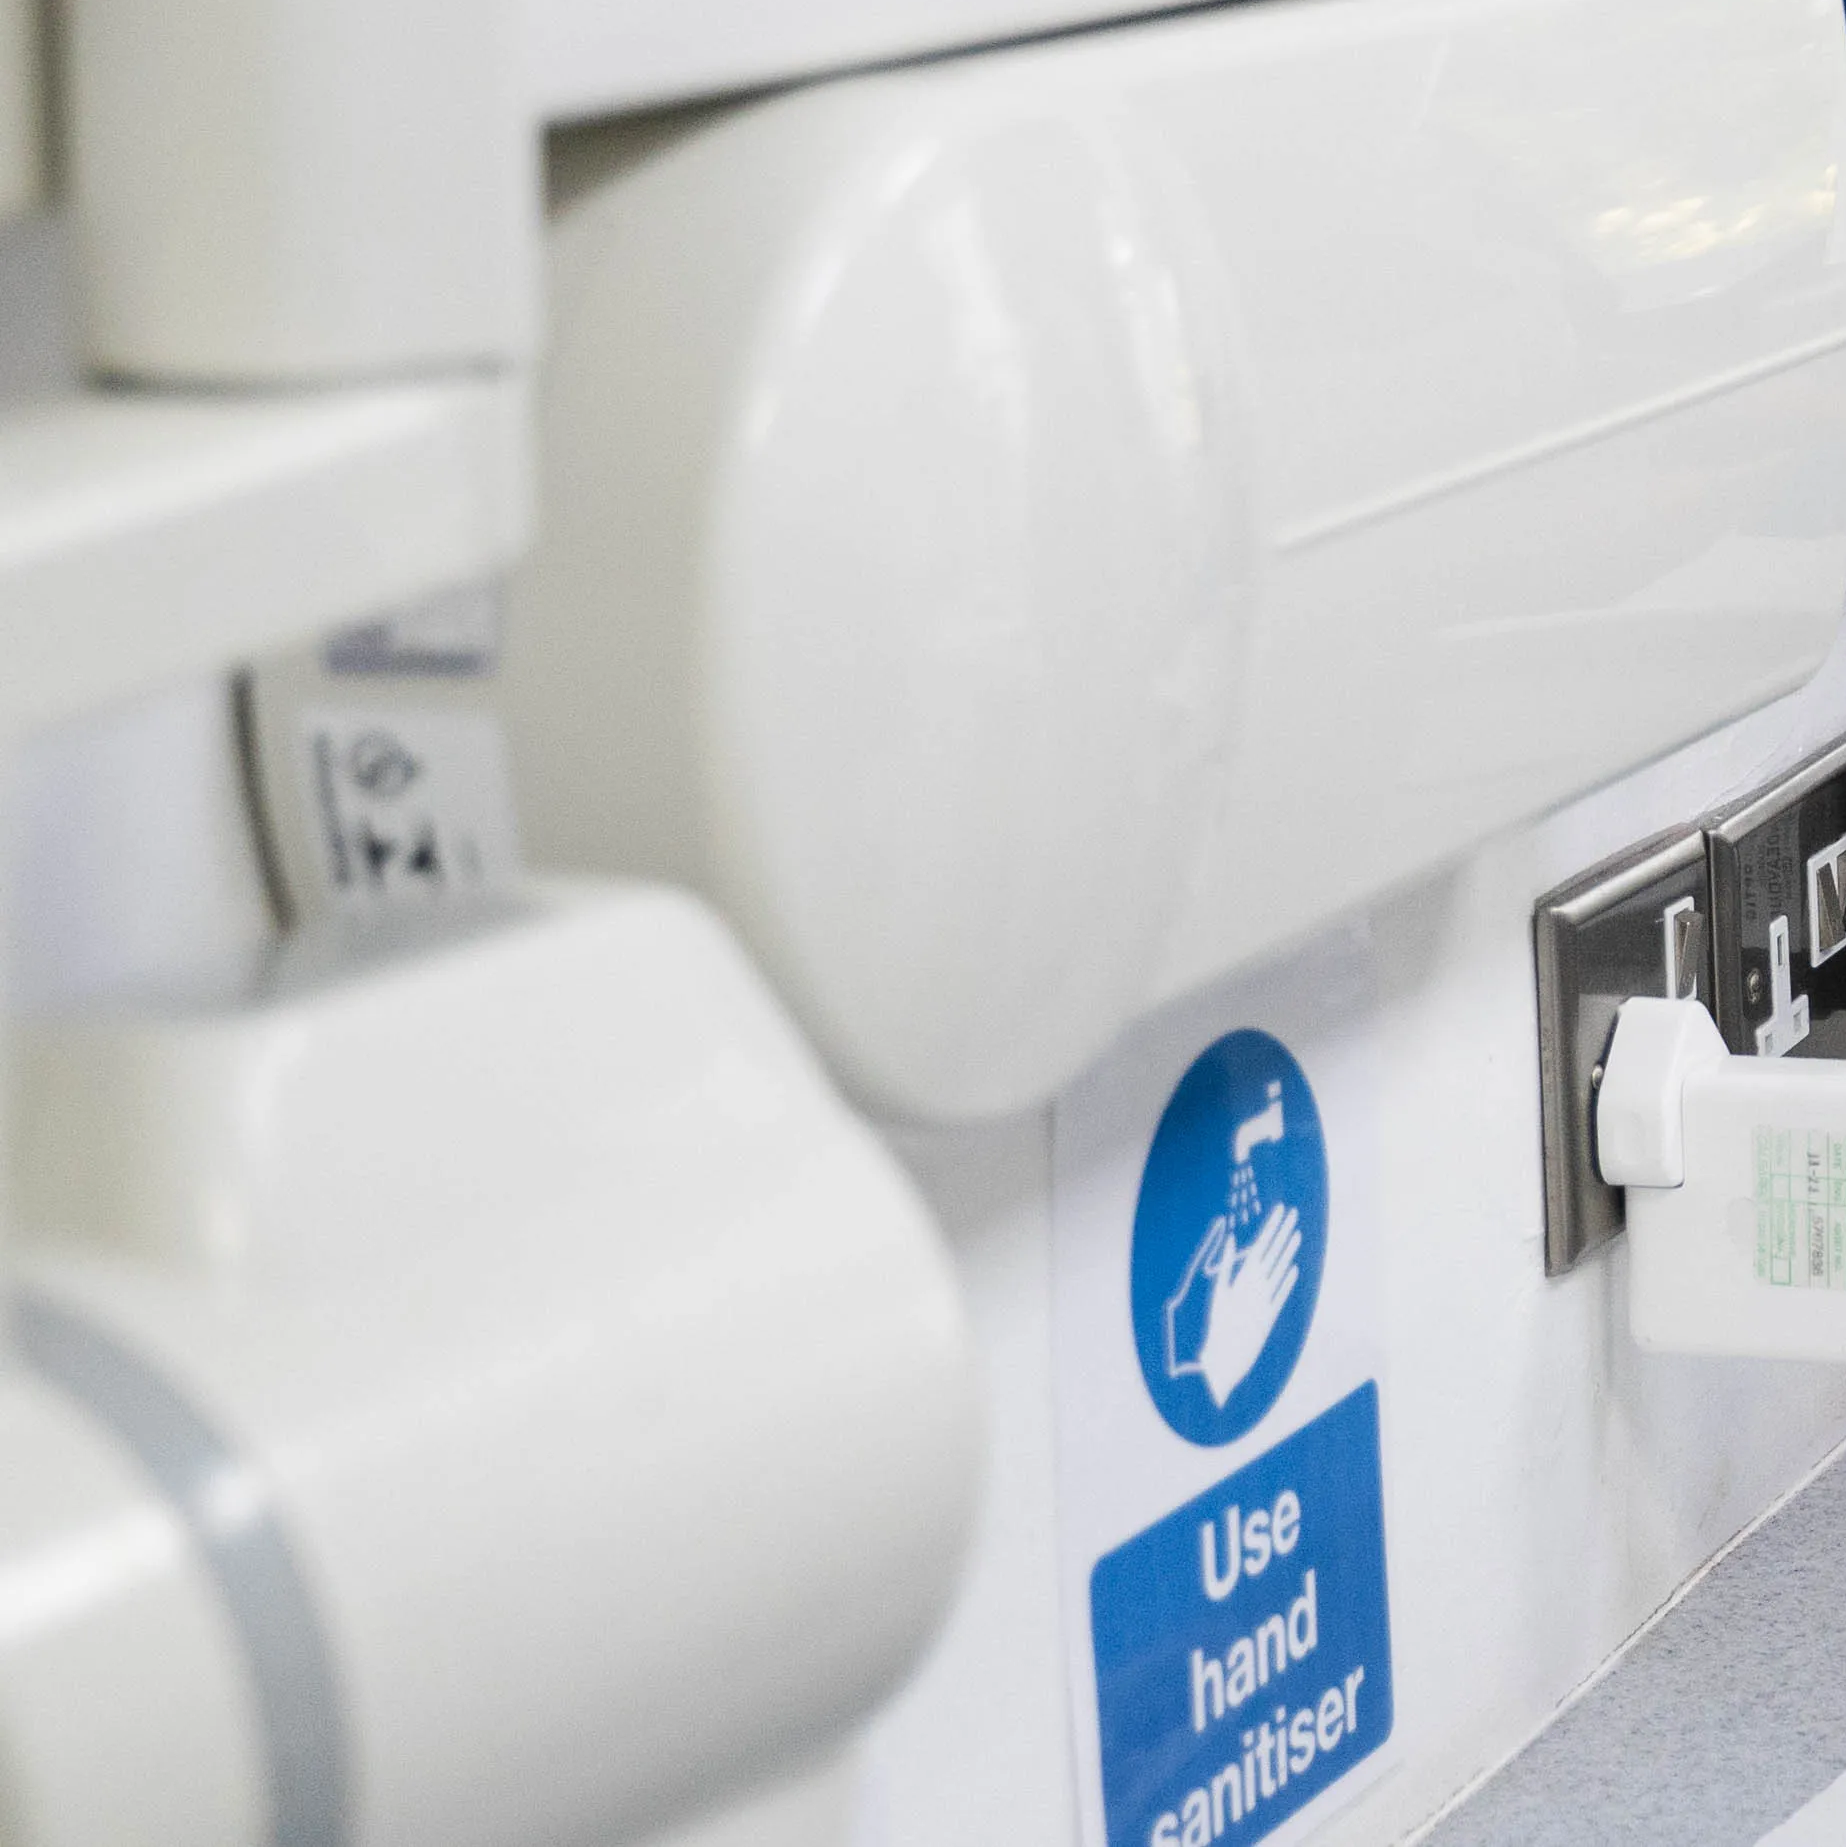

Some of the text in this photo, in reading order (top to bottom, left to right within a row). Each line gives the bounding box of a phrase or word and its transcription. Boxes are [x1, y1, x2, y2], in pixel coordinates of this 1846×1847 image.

[1201, 1489, 1301, 1601] Use
[1187, 1568, 1318, 1734] hand
[1149, 1665, 1364, 1847] sanitiser
